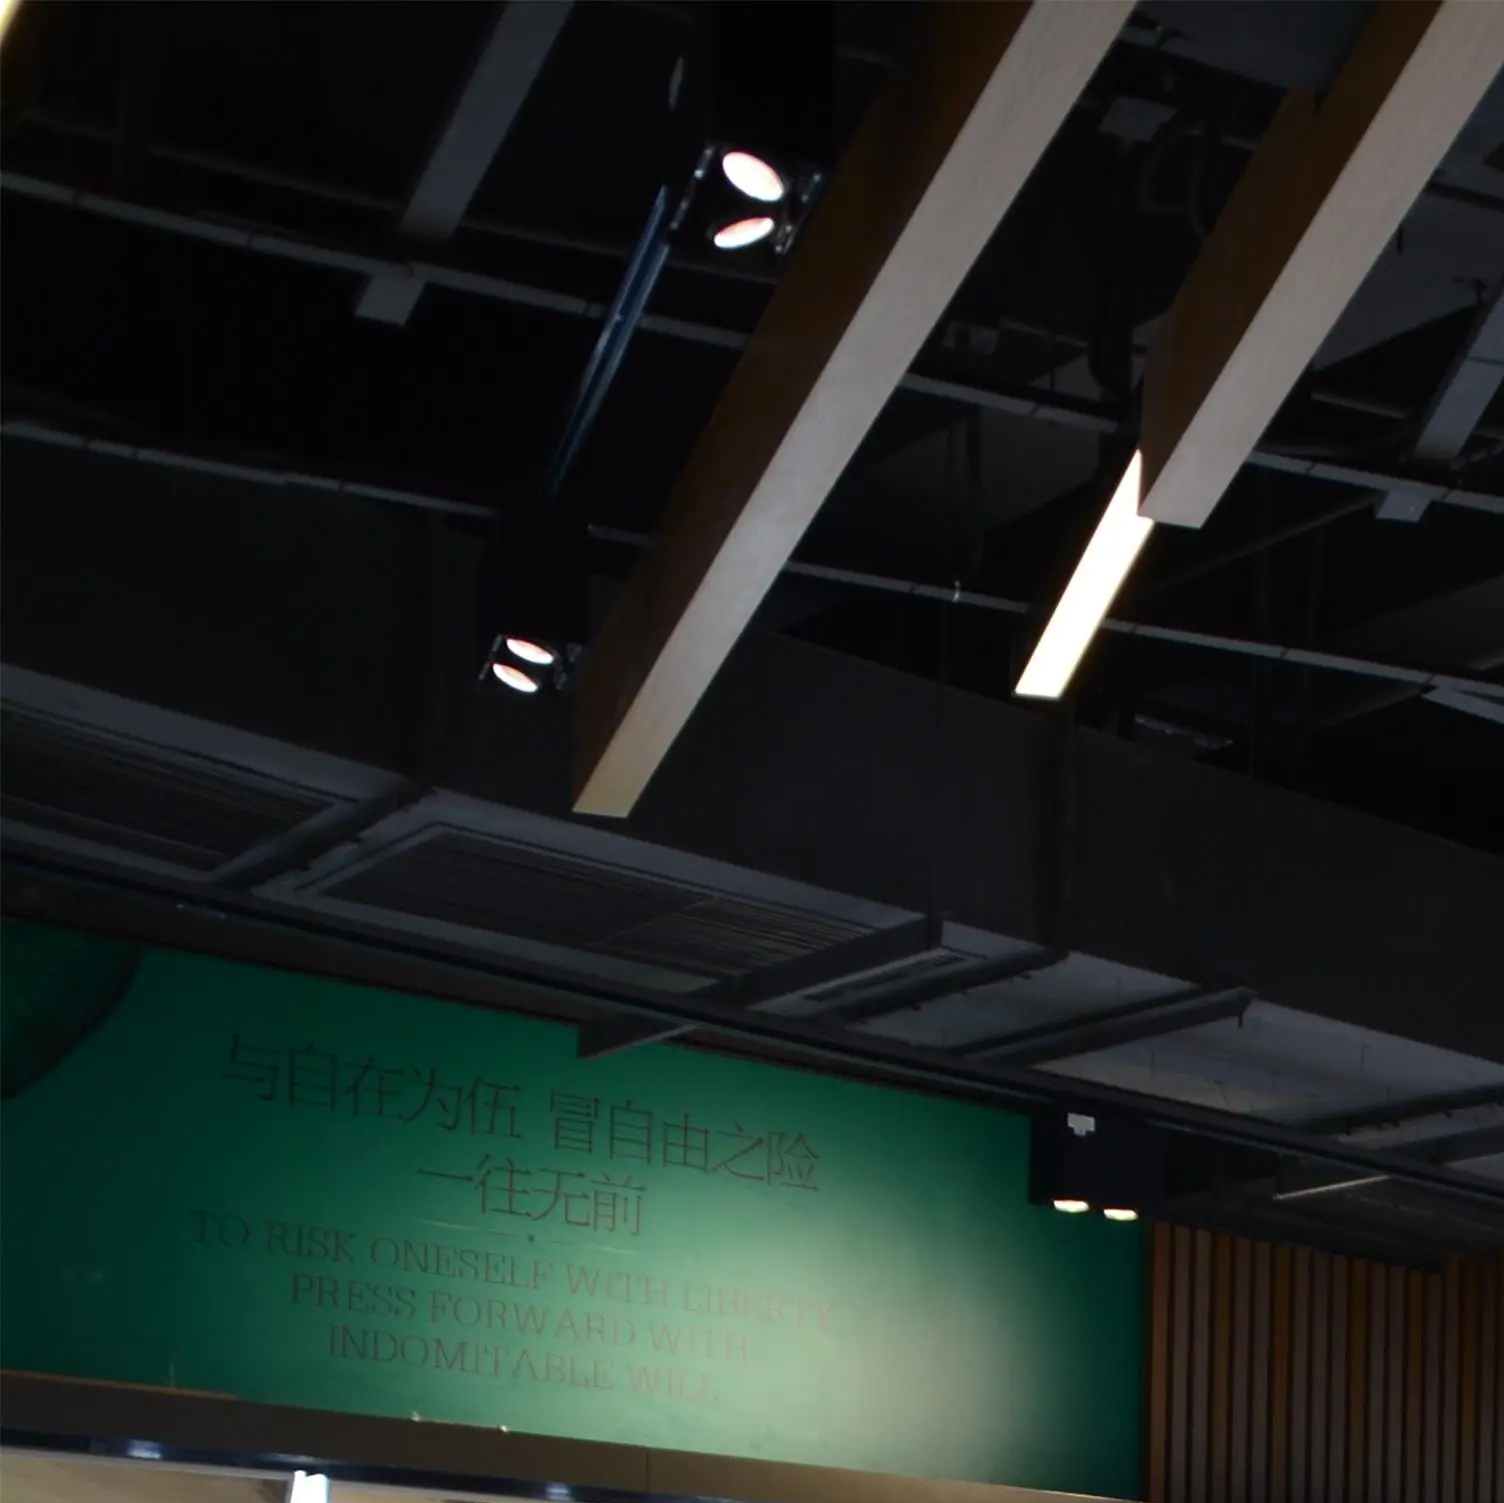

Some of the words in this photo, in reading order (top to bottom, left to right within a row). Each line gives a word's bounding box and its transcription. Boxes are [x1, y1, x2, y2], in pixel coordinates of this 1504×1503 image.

[224, 1033, 523, 1139] 与自在为伍
[550, 1090, 820, 1191] 冒自由之险
[417, 1154, 647, 1236] 一往无前
[190, 1208, 250, 1247] TO
[265, 1221, 355, 1264] RISK
[370, 1236, 555, 1291] ONESELF
[565, 1264, 668, 1311] WITH
[683, 1280, 836, 1334] LIBERTY
[290, 1271, 416, 1318] PRESS
[429, 1290, 636, 1345] FORWARD
[648, 1321, 750, 1364] WITH
[327, 1322, 613, 1389] INDOMITABLE
